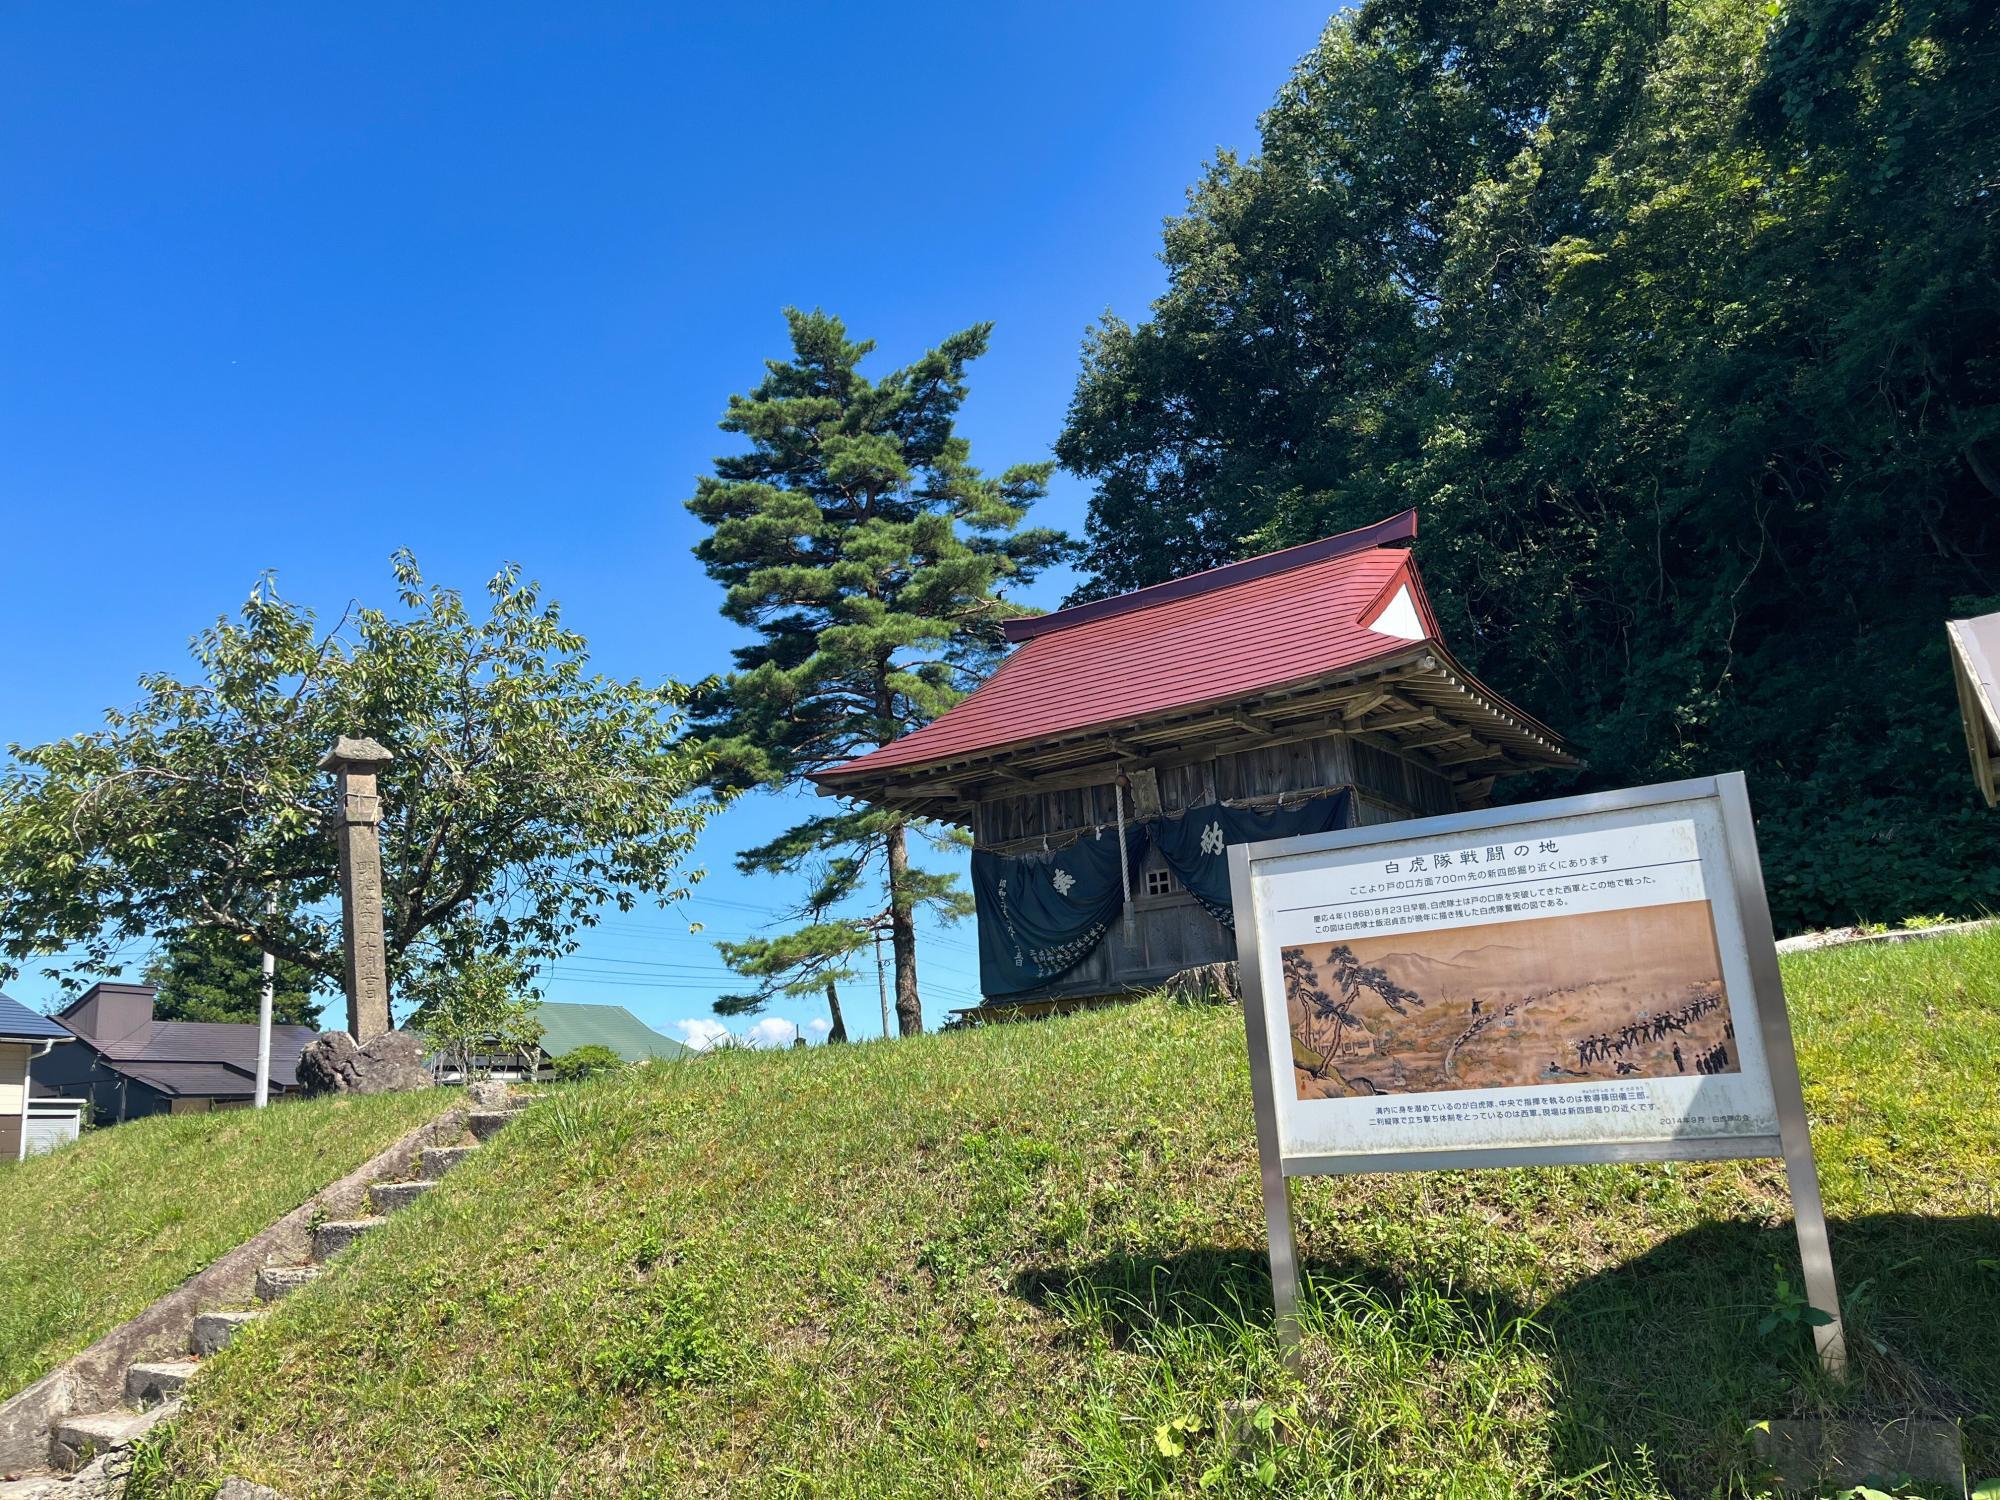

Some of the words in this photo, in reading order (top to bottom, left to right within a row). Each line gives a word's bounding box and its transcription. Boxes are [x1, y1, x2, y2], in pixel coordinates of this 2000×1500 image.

[1052, 868, 1077, 897] 奉
[1200, 820, 1225, 857] 納
[1385, 839, 1560, 874] 白虎隊戦闘の地
